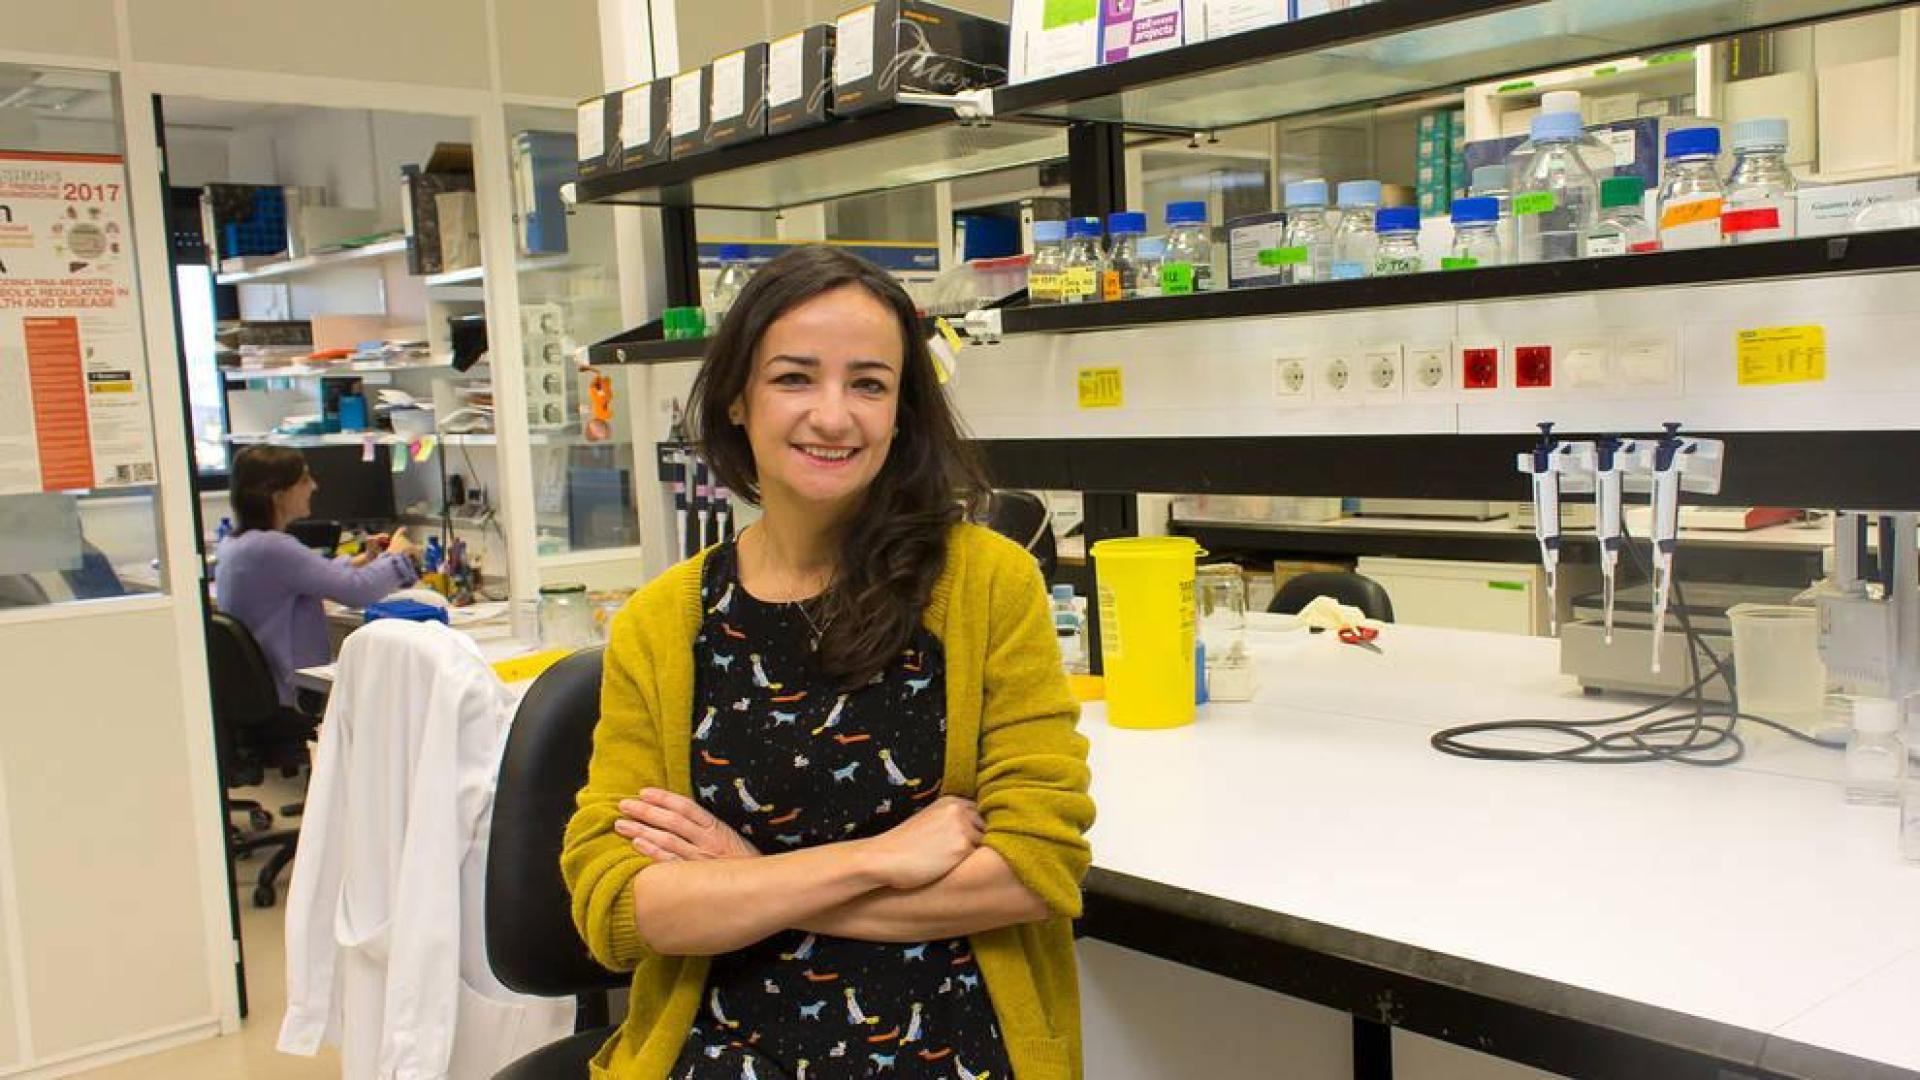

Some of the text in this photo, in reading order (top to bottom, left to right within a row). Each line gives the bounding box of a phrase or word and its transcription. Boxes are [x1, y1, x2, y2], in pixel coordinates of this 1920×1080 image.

[64, 183, 120, 201] 2017
[38, 288, 115, 297] REGULATION
[26, 298, 55, 308] AND
[58, 298, 114, 308] DISEASE
